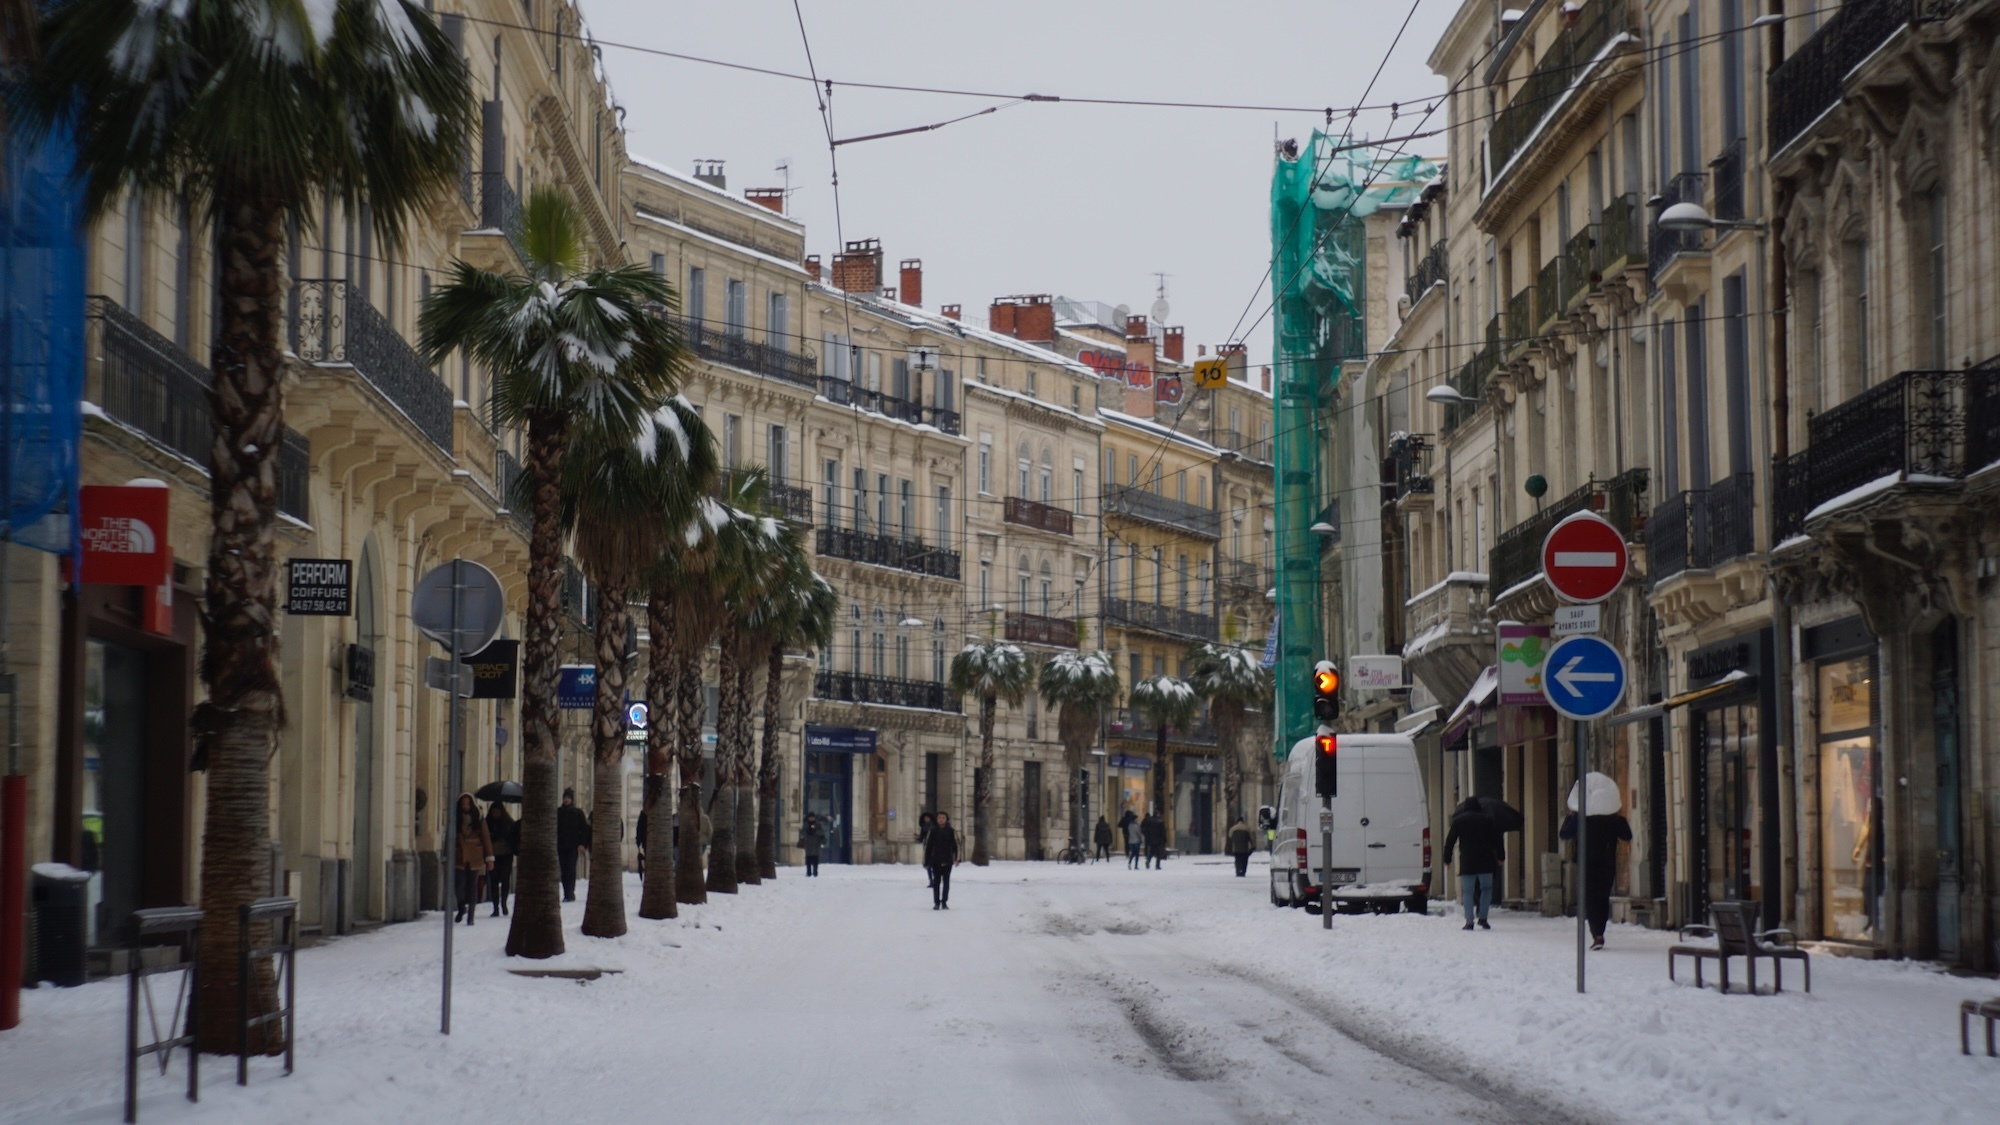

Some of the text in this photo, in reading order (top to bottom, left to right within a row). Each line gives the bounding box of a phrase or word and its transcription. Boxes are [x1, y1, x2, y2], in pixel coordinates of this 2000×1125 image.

[1199, 367, 1222, 381] 10
[100, 517, 130, 530] THE
[91, 540, 129, 553] FACE
[291, 563, 347, 585] PERFORM
[291, 587, 347, 599] COIFFURE
[1570, 610, 1584, 619] SAUF
[1558, 619, 1596, 631] AYANTS DROIT
